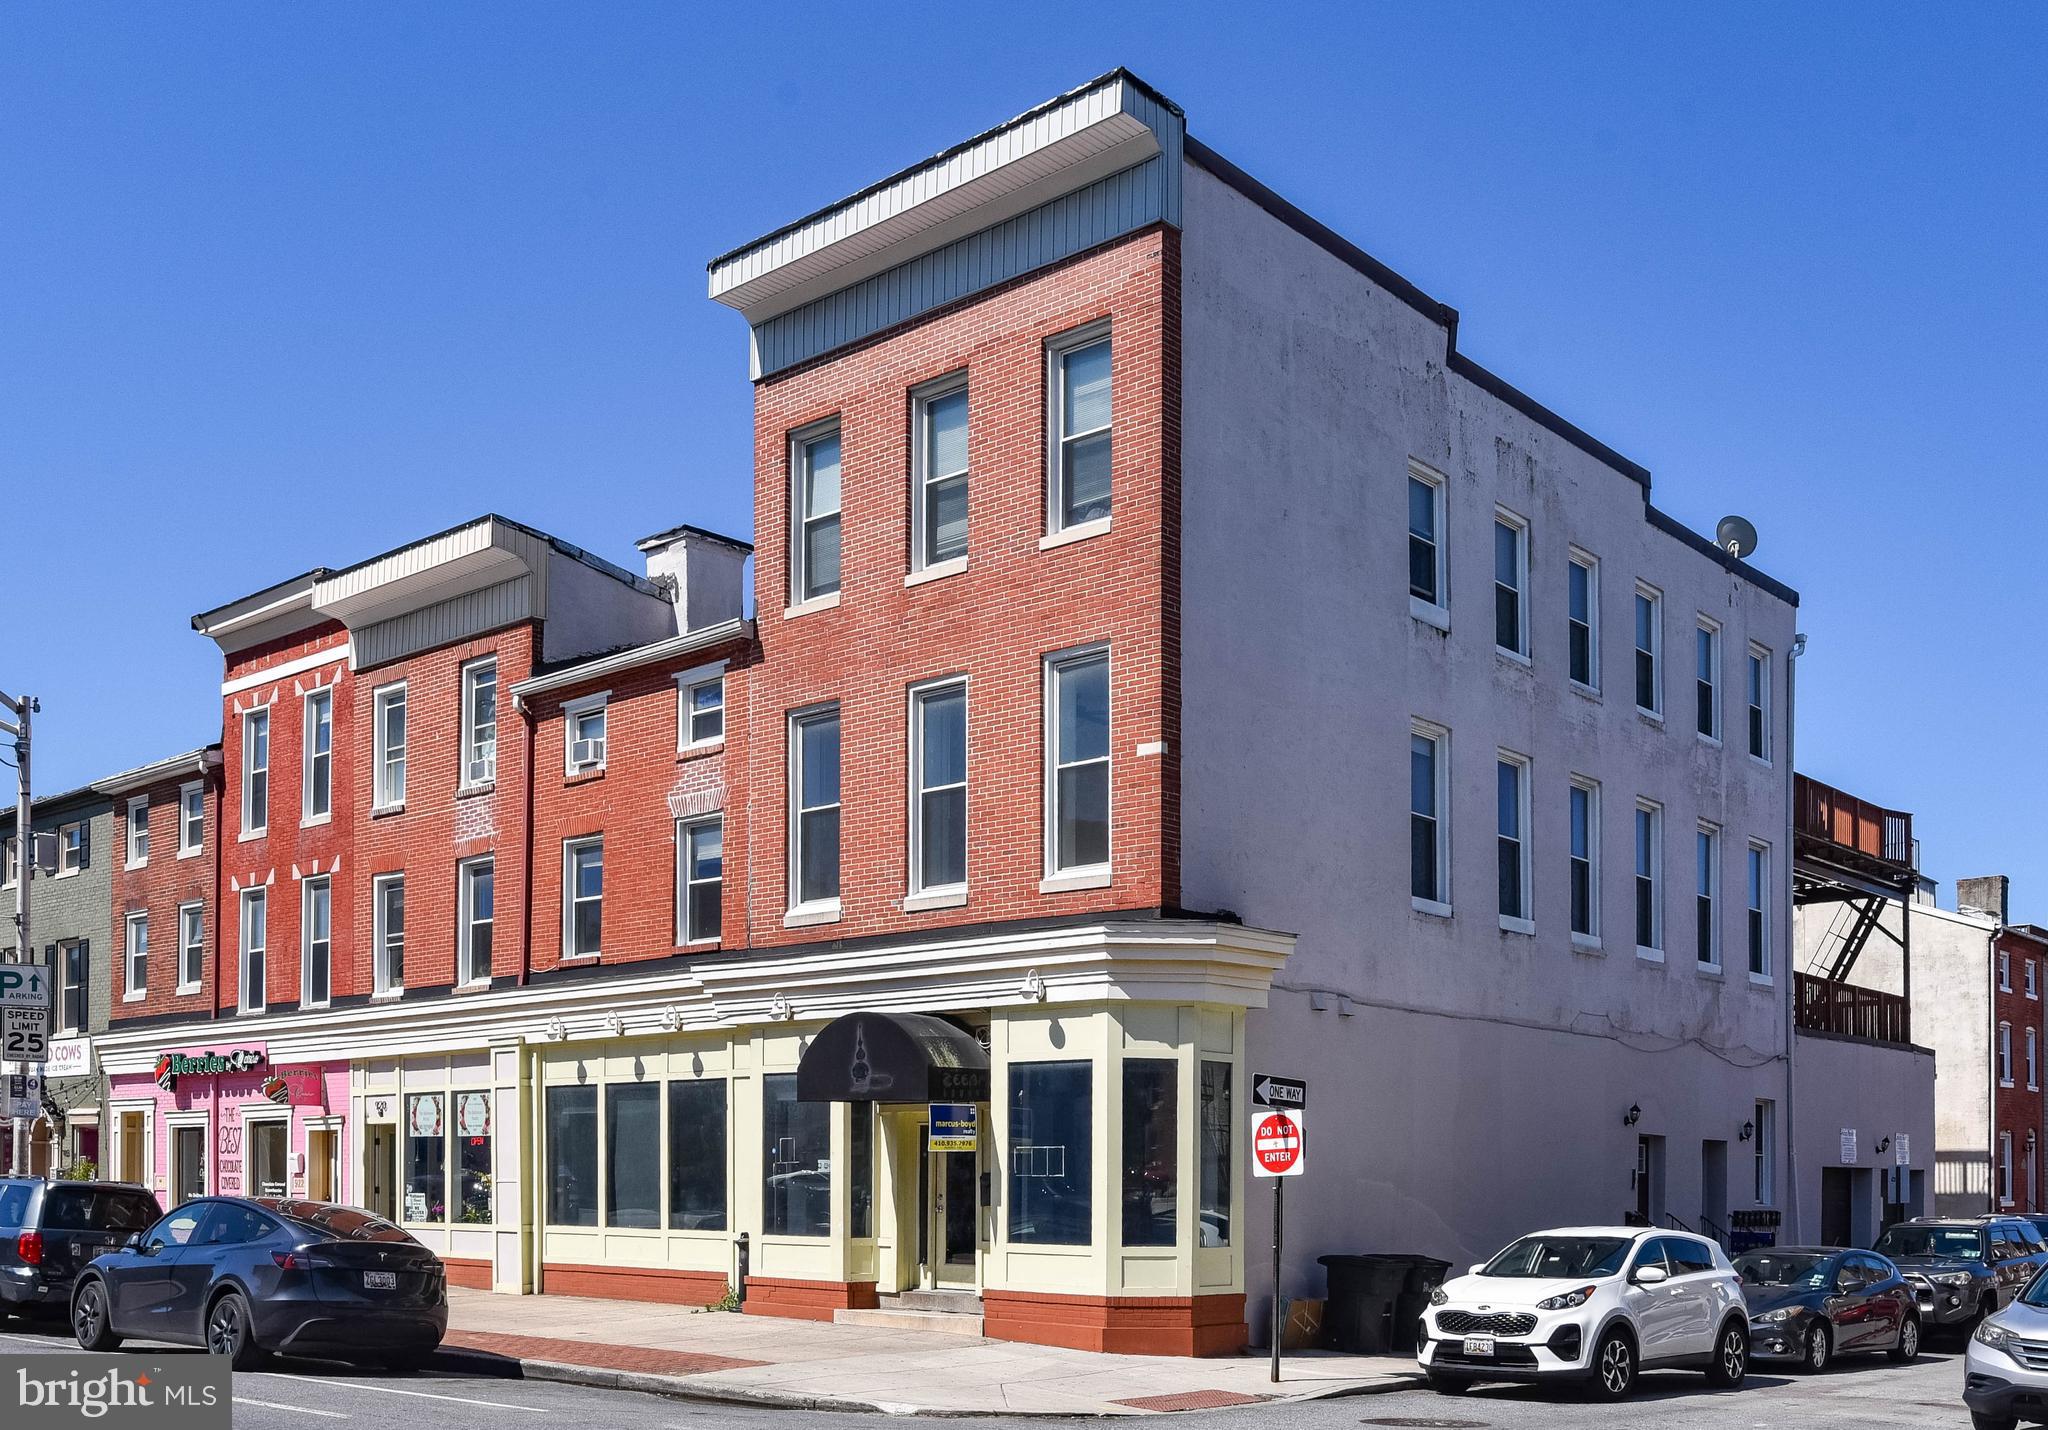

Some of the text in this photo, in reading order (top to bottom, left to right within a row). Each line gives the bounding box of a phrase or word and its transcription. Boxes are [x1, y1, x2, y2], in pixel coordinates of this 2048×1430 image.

[7, 1010, 44, 1020] SPEED
[12, 1022, 40, 1031] LIMIT
[7, 1032, 44, 1053] 25
[55, 1045, 82, 1061] COWS
[172, 1053, 225, 1076] Berries
[1269, 1085, 1302, 1100] ONE WAY
[225, 1107, 236, 1122] THE
[1260, 1124, 1294, 1136] DO NOT
[219, 1125, 243, 1155] BEST
[1264, 1152, 1291, 1162] ENTER
[219, 1160, 243, 1174] CHOCOLATE
[221, 1177, 240, 1190] COVERED
